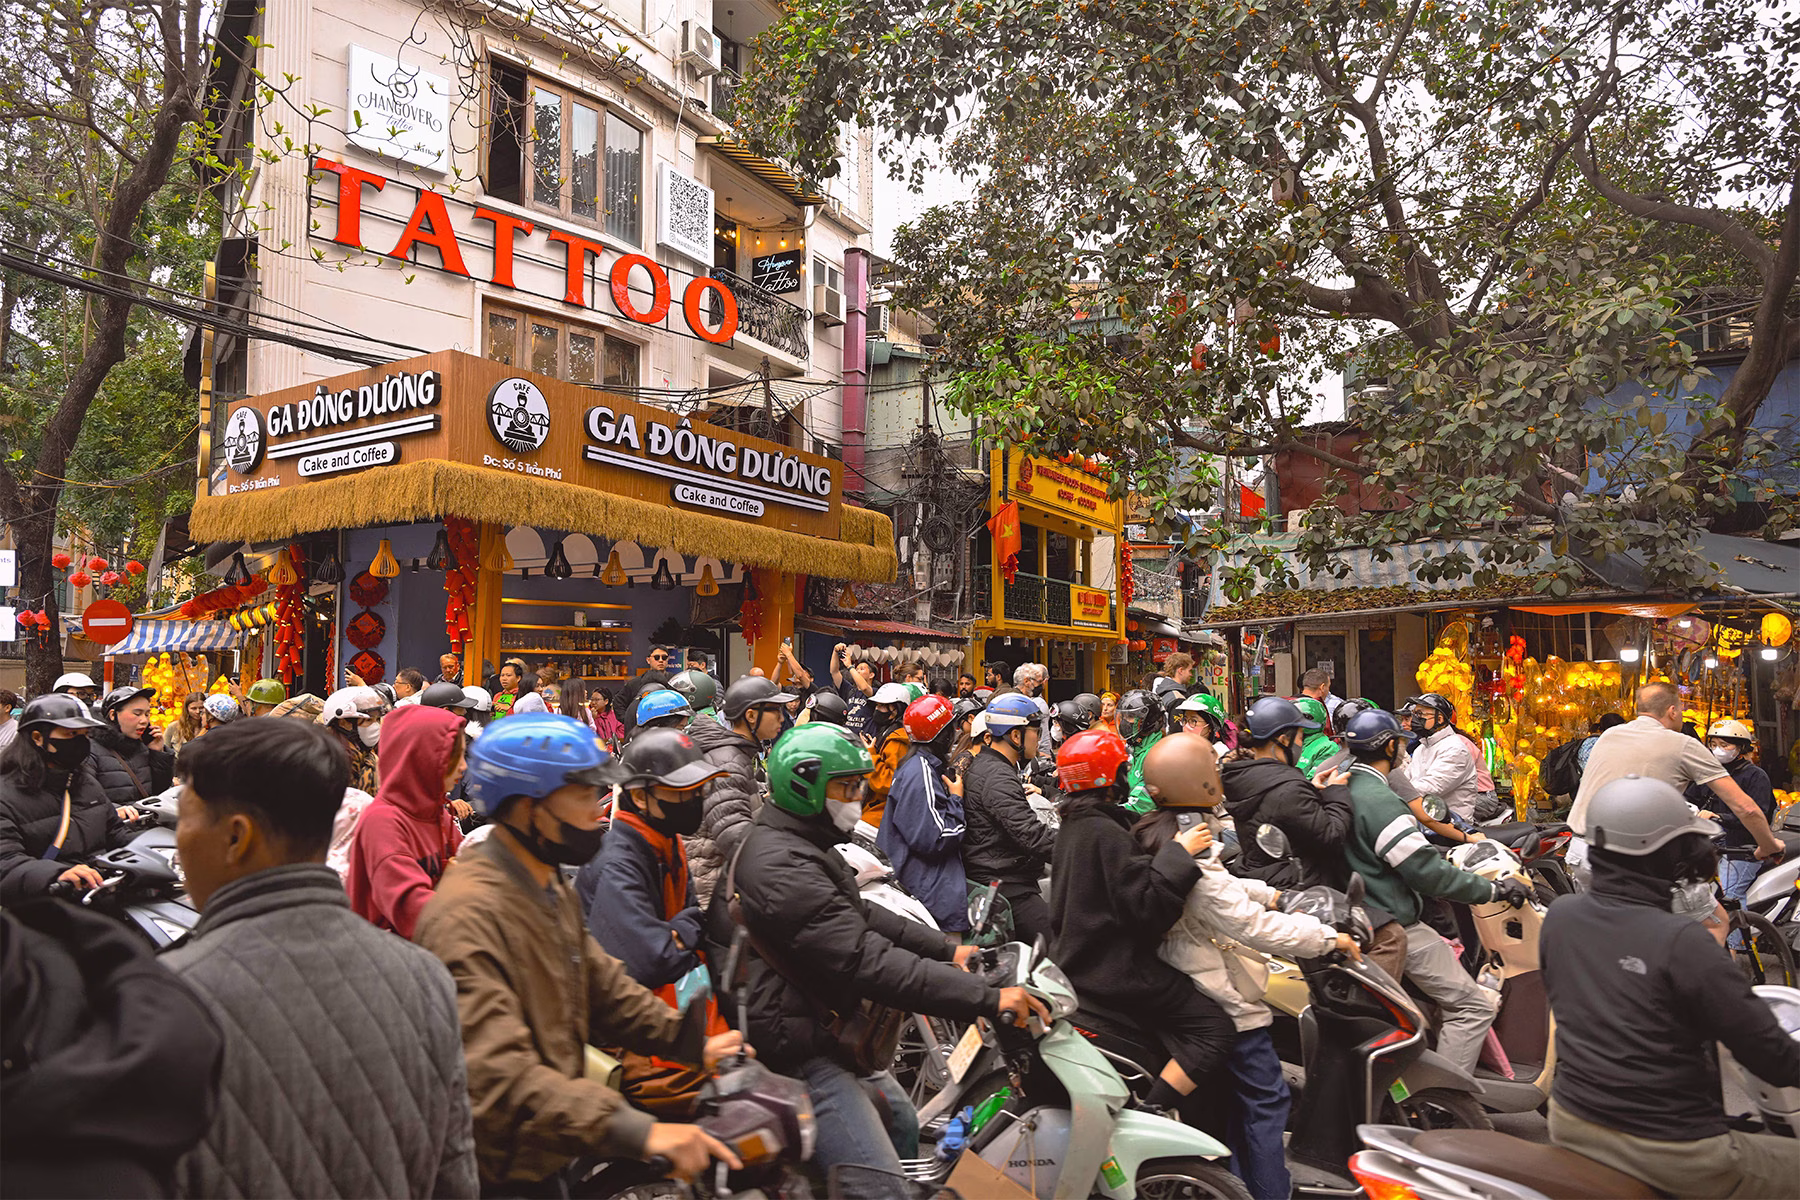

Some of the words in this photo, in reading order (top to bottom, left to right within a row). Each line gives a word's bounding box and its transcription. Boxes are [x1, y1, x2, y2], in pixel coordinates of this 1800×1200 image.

[357, 91, 443, 133] HANGOVER
[376, 112, 414, 131] tattoo
[313, 157, 739, 344] TATTOO
[753, 269, 799, 292] Tattoo
[266, 404, 294, 438] GA
[297, 384, 353, 431] ĐÔNG
[358, 370, 436, 418] DƯƠNG
[303, 456, 328, 473] Cake
[331, 452, 350, 467] and
[353, 447, 388, 464] Coffee
[586, 405, 641, 450] GA
[646, 417, 738, 474] ĐÔNG
[741, 447, 832, 496] DƯƠNG
[502, 457, 517, 471] Số
[517, 461, 524, 472] 5
[525, 461, 544, 476] Trần
[545, 467, 562, 480] Phú
[250, 480, 255, 491] 5
[681, 487, 707, 503] Cake
[709, 495, 727, 507] and
[730, 497, 760, 514] Coffee
[1205, 666, 1222, 677] NO
